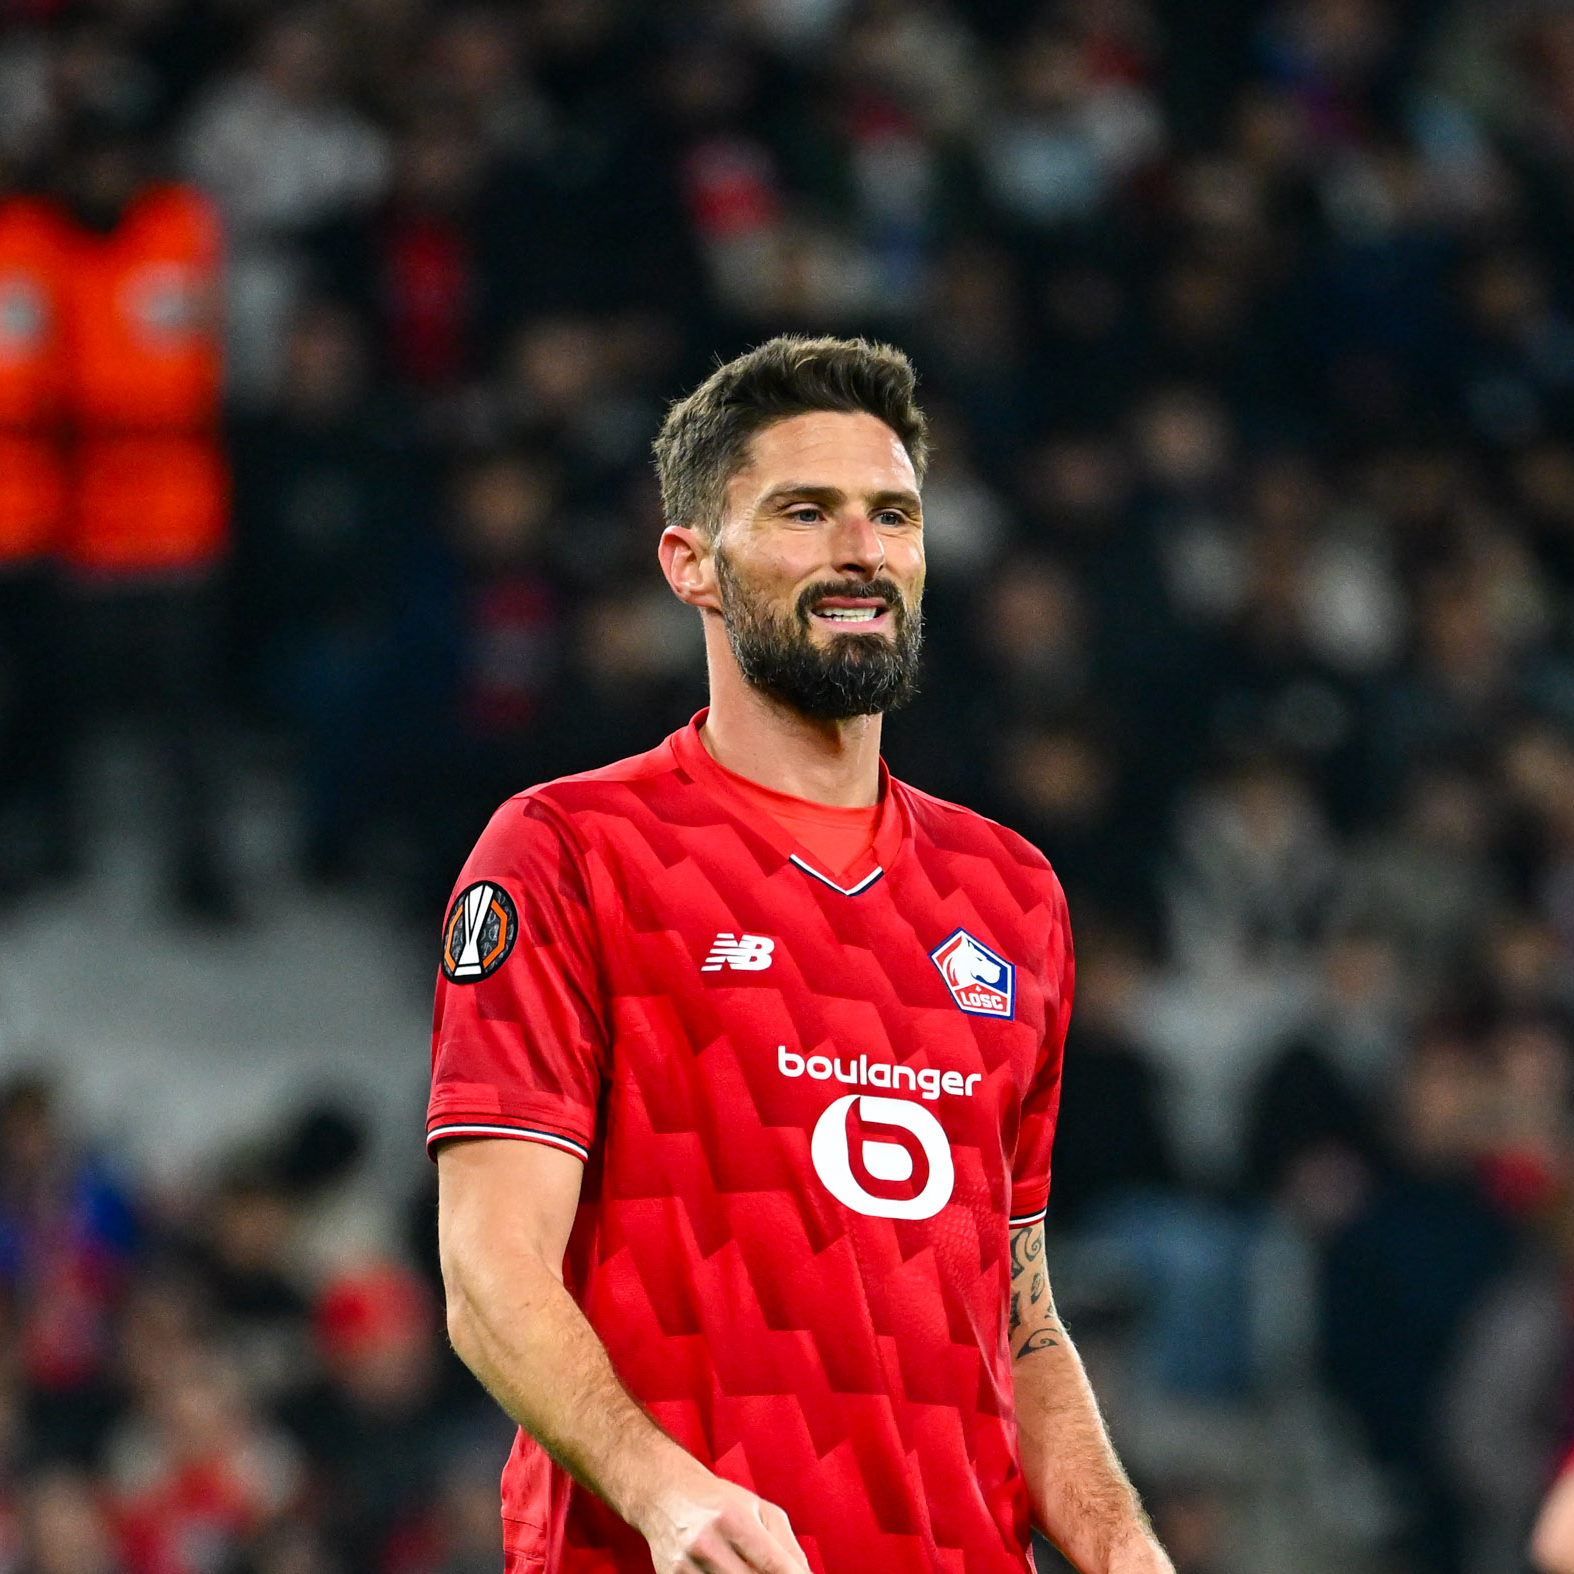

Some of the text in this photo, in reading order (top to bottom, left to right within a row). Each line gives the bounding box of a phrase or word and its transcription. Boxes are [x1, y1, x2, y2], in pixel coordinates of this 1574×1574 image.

[701, 933, 775, 971] NB
[960, 991, 1003, 1010] LOSC
[778, 1045, 982, 1100] boulanger
